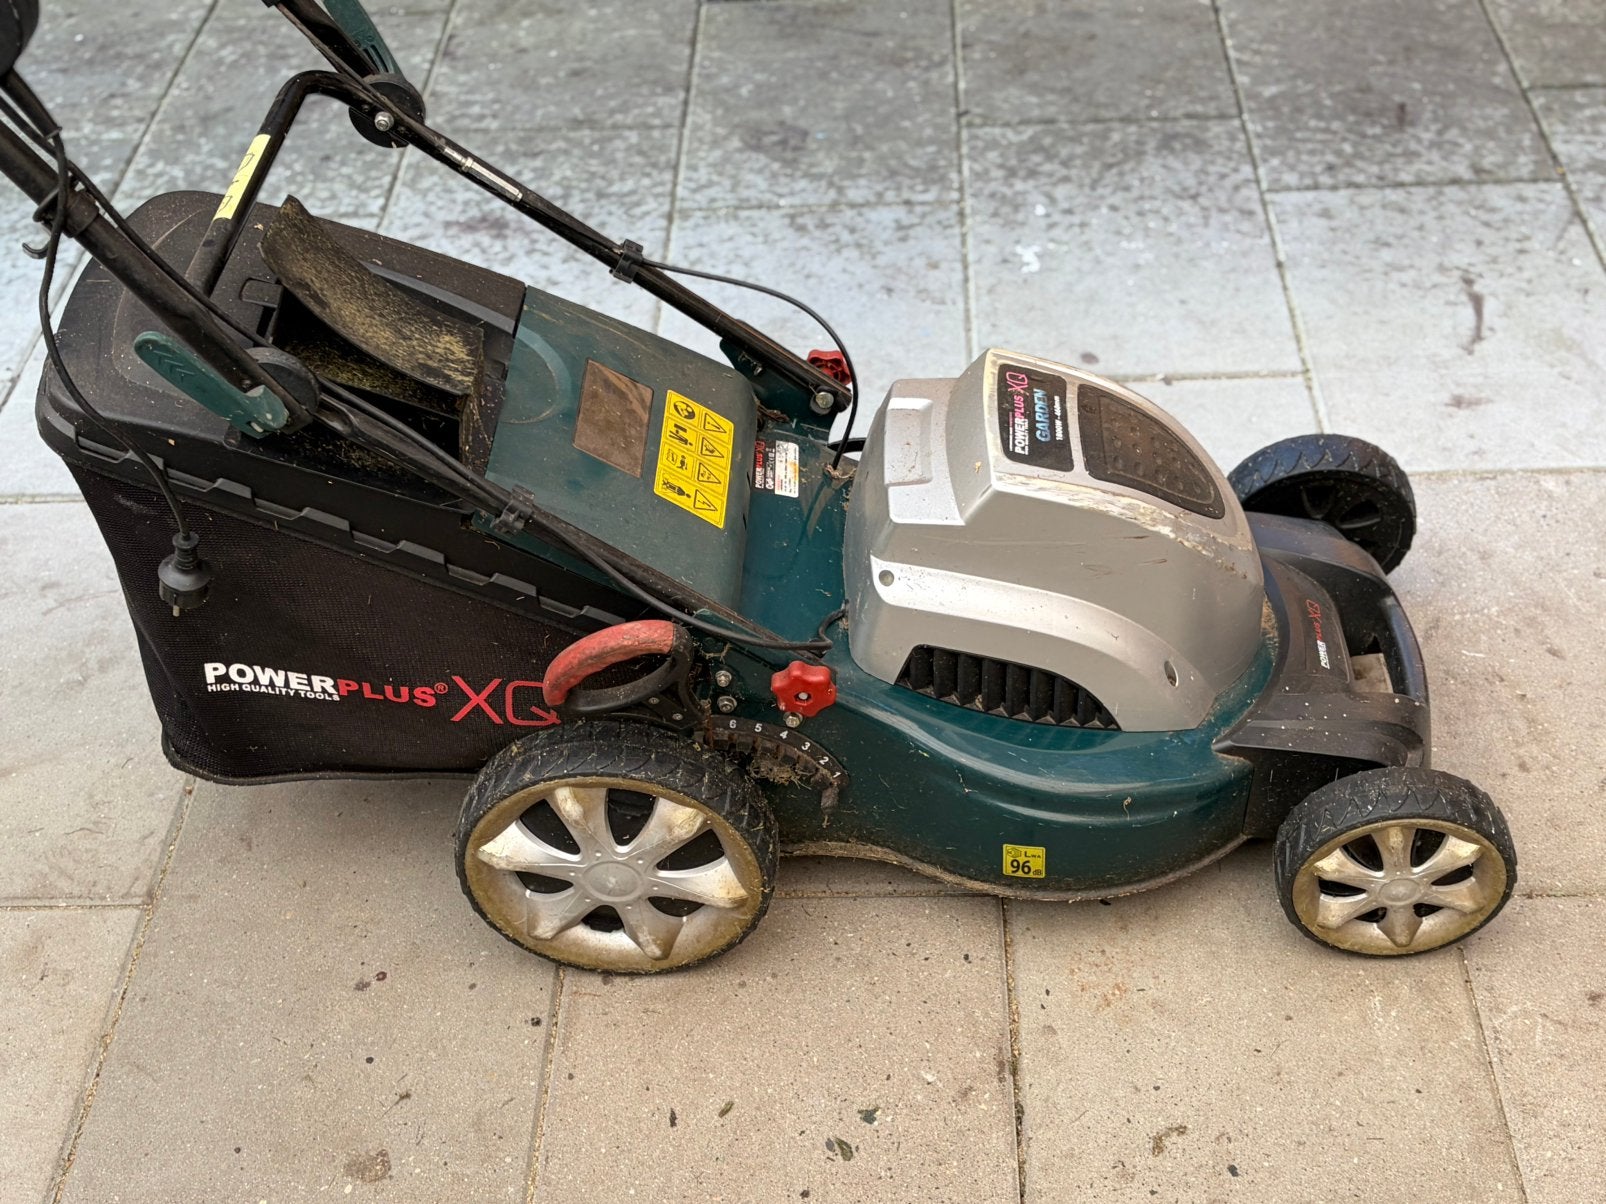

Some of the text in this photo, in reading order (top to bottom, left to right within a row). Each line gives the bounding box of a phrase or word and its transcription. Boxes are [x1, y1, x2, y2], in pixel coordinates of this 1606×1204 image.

[1014, 394, 1025, 455] POWERPLUS
[1033, 389, 1050, 442] GARDEN
[1055, 420, 1063, 440] 1800W
[207, 683, 341, 701] HIGH QUALITY TOOLS
[450, 675, 562, 727] XQ
[730, 720, 737, 729] 6
[754, 723, 762, 732] 5
[780, 730, 789, 739] 4
[802, 742, 811, 750] 3
[819, 756, 829, 765] 2
[1010, 858, 1031, 874] 96
